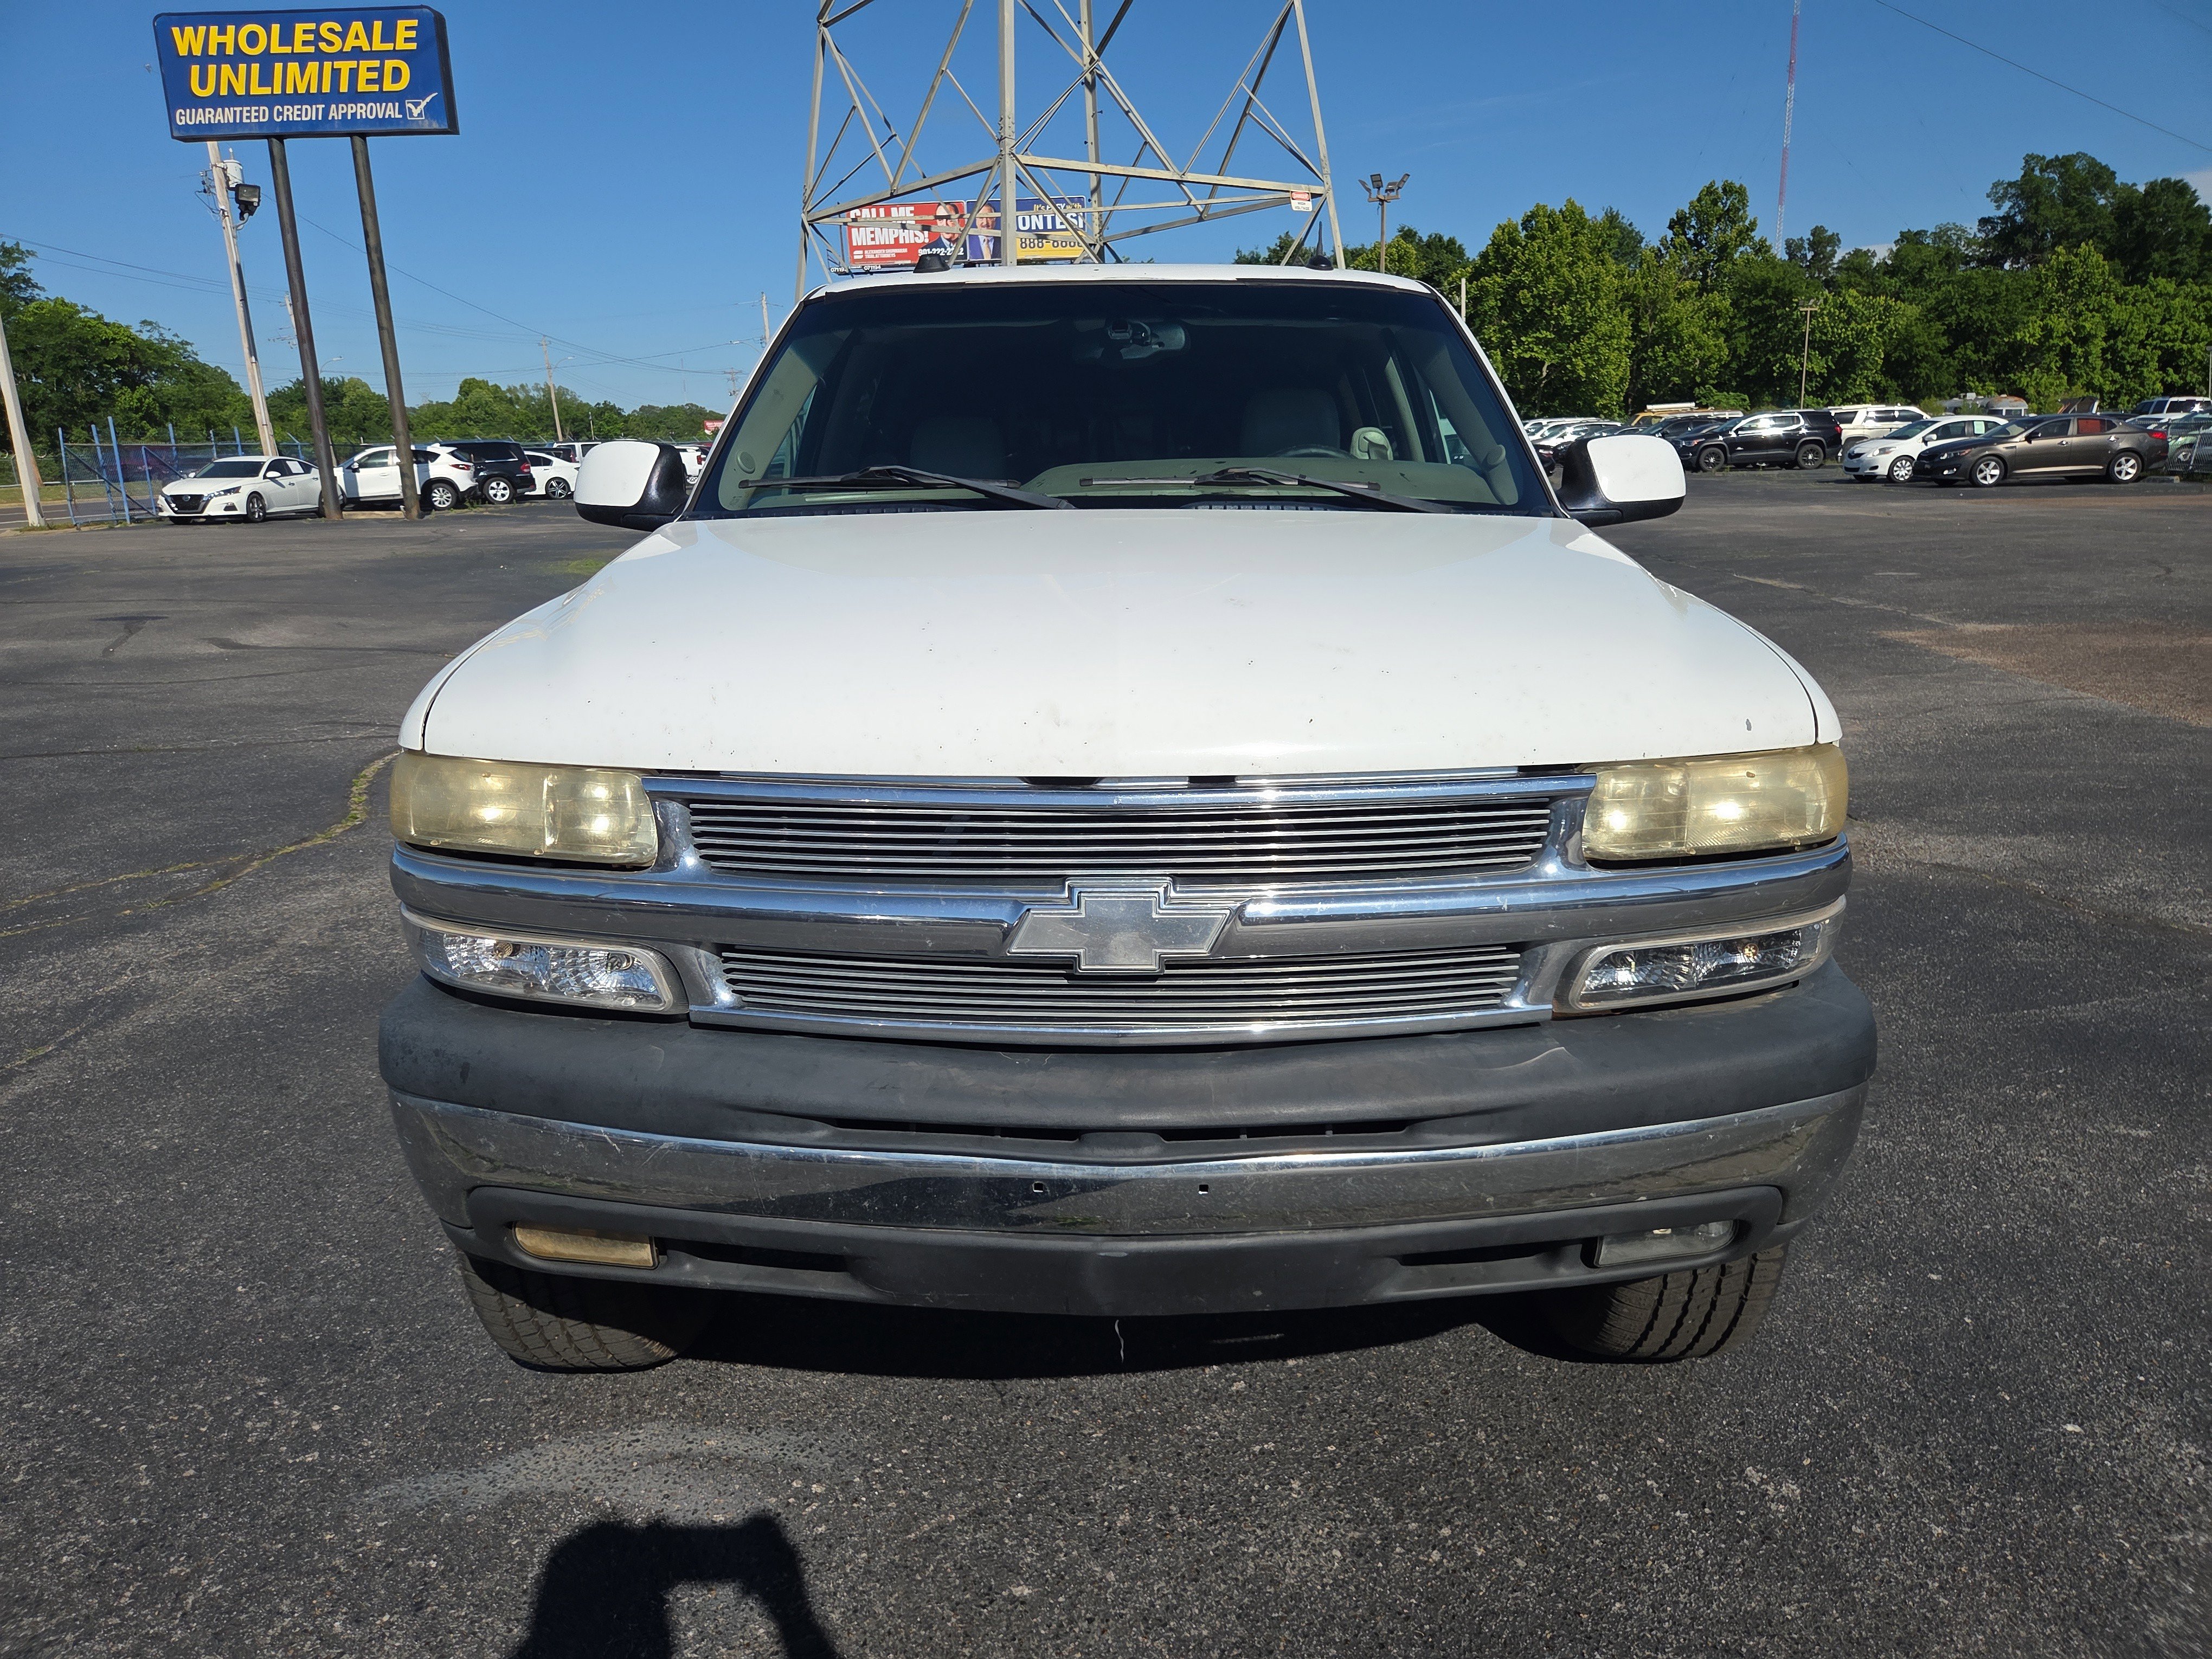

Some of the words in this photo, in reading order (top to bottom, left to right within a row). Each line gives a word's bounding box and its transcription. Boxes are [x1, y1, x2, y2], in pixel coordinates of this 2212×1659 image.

[171, 19, 419, 56] WHOLESALE
[190, 59, 410, 97] UNLIMITED
[176, 106, 269, 125] GUARANTEED
[273, 104, 325, 122] CREDIT
[328, 102, 402, 121] APPROVAL
[1016, 213, 1083, 230] ONTESI
[852, 227, 929, 246] MEMPHIS!
